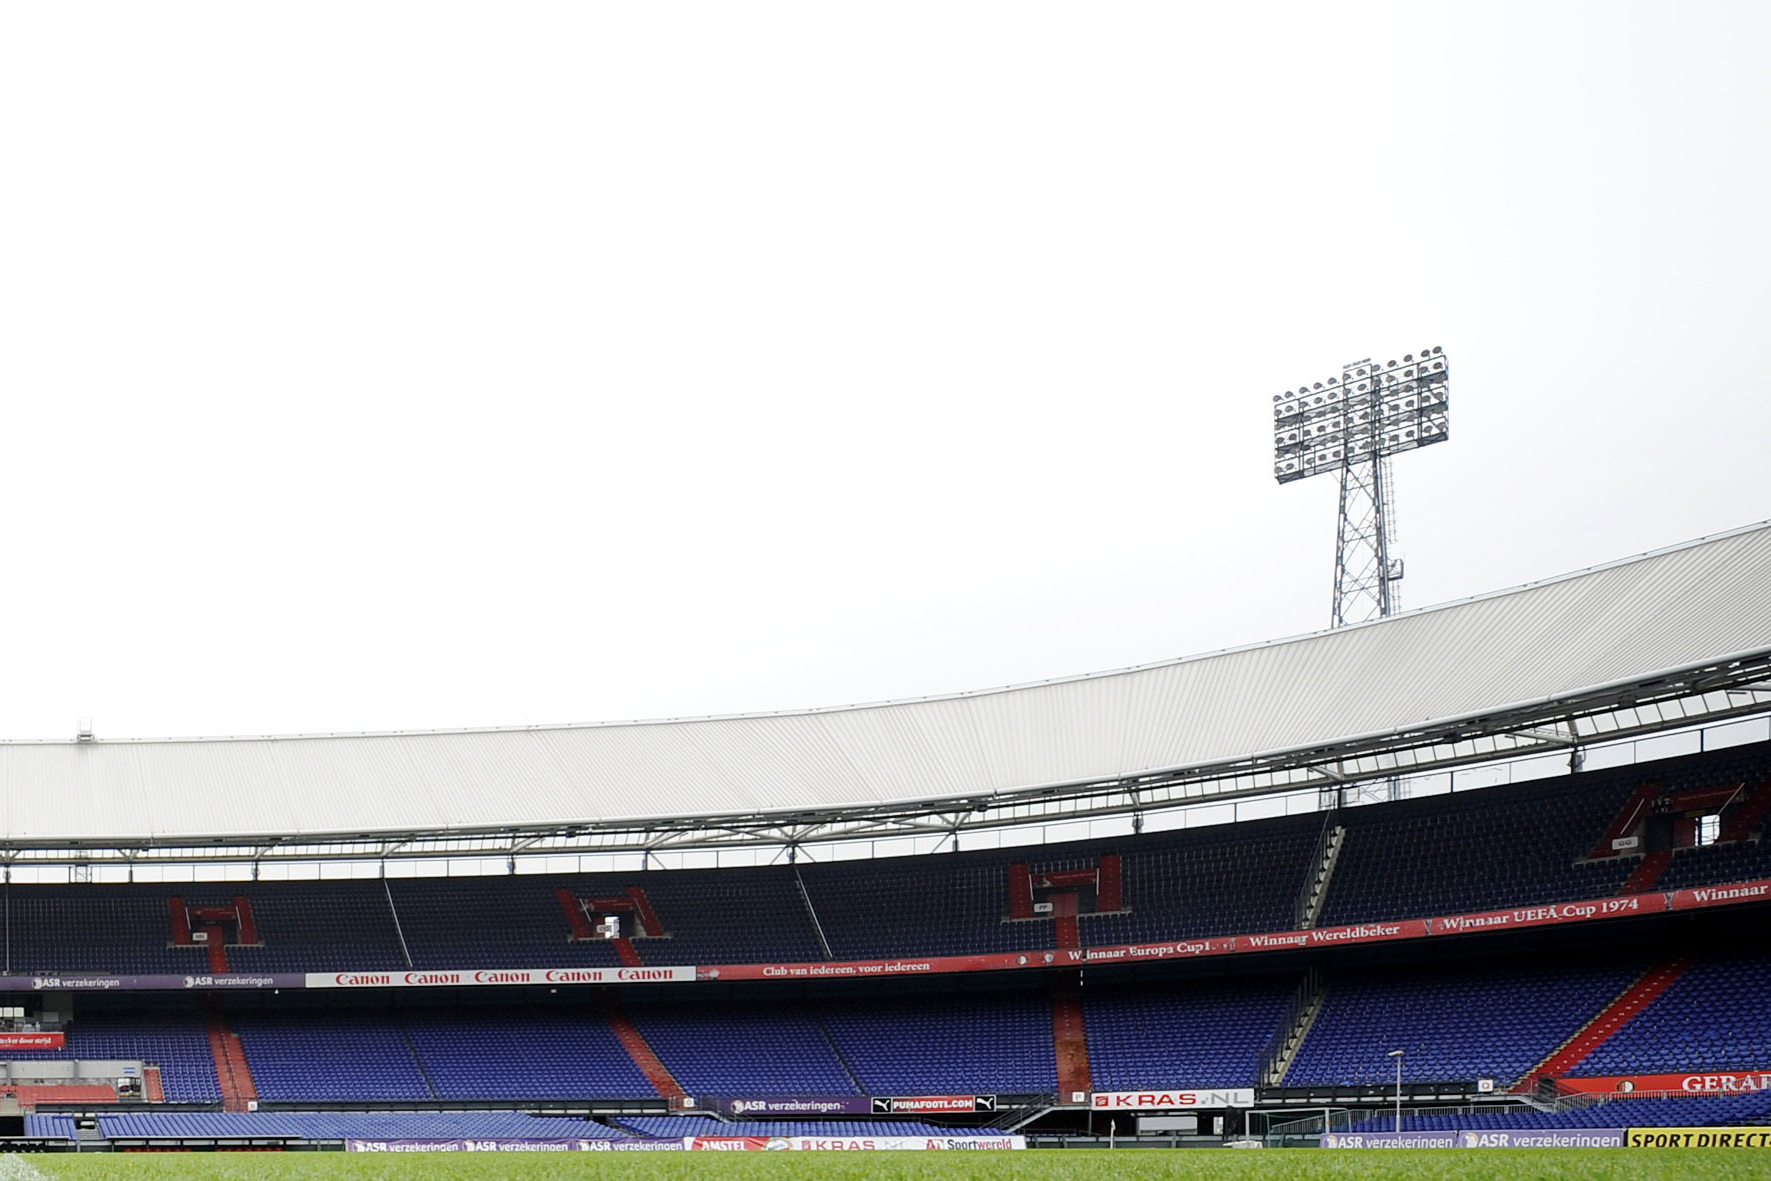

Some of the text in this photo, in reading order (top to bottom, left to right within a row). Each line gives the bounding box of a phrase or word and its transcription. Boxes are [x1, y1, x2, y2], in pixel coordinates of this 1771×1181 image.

[1693, 885, 1769, 903] Winnaar
[1443, 898, 1638, 930] Winnaar UEFA Cup 1974
[1248, 926, 1400, 947] Winnaar Wereldbeker
[1128, 944, 1174, 958] Europa
[545, 969, 603, 981] Canon
[617, 967, 674, 980] Canon
[763, 966, 789, 977] Club
[790, 967, 808, 976] van
[859, 963, 884, 973] voor
[885, 962, 930, 972] iedereen
[42, 978, 120, 988] ASR verzekeringen
[194, 976, 274, 987] ASR verzekeringen
[335, 973, 391, 985] Canon
[404, 972, 460, 984] Canon
[474, 971, 531, 983] Canon
[744, 1100, 841, 1113] ASR verzekeringen
[476, 1141, 568, 1152] ASR verzekeringen
[588, 1141, 683, 1151] ASR verzekeringen
[701, 1140, 746, 1150] AMSTEL
[946, 1139, 1013, 1150] Sportwereld
[1337, 1137, 1454, 1149] ASR verzekeringen
[1478, 1134, 1622, 1147] ASR verzekeringen
[1631, 1134, 1694, 1148] SPORT
[366, 1142, 459, 1153] ASR verzekeringen
